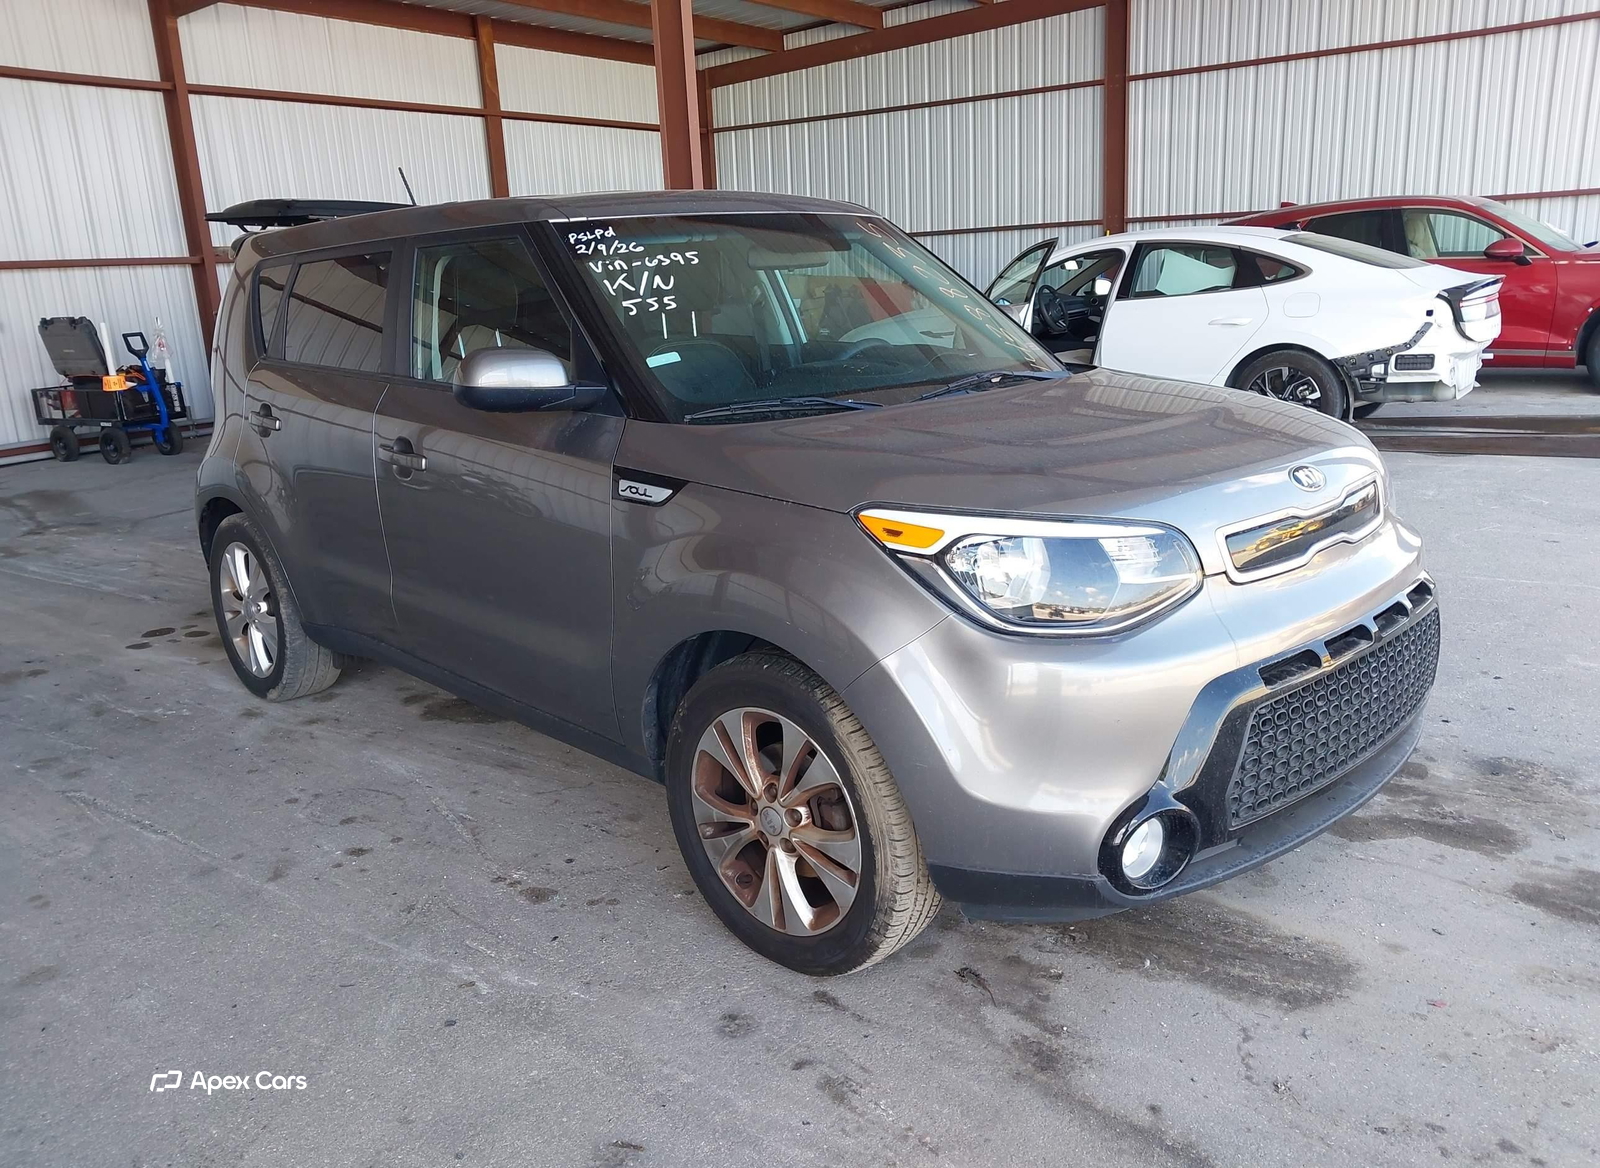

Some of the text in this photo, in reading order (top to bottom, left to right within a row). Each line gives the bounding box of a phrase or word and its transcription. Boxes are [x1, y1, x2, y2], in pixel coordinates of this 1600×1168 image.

[575, 240, 645, 256] 2/9/26
[603, 271, 675, 296] K/N
[622, 296, 677, 316] 555
